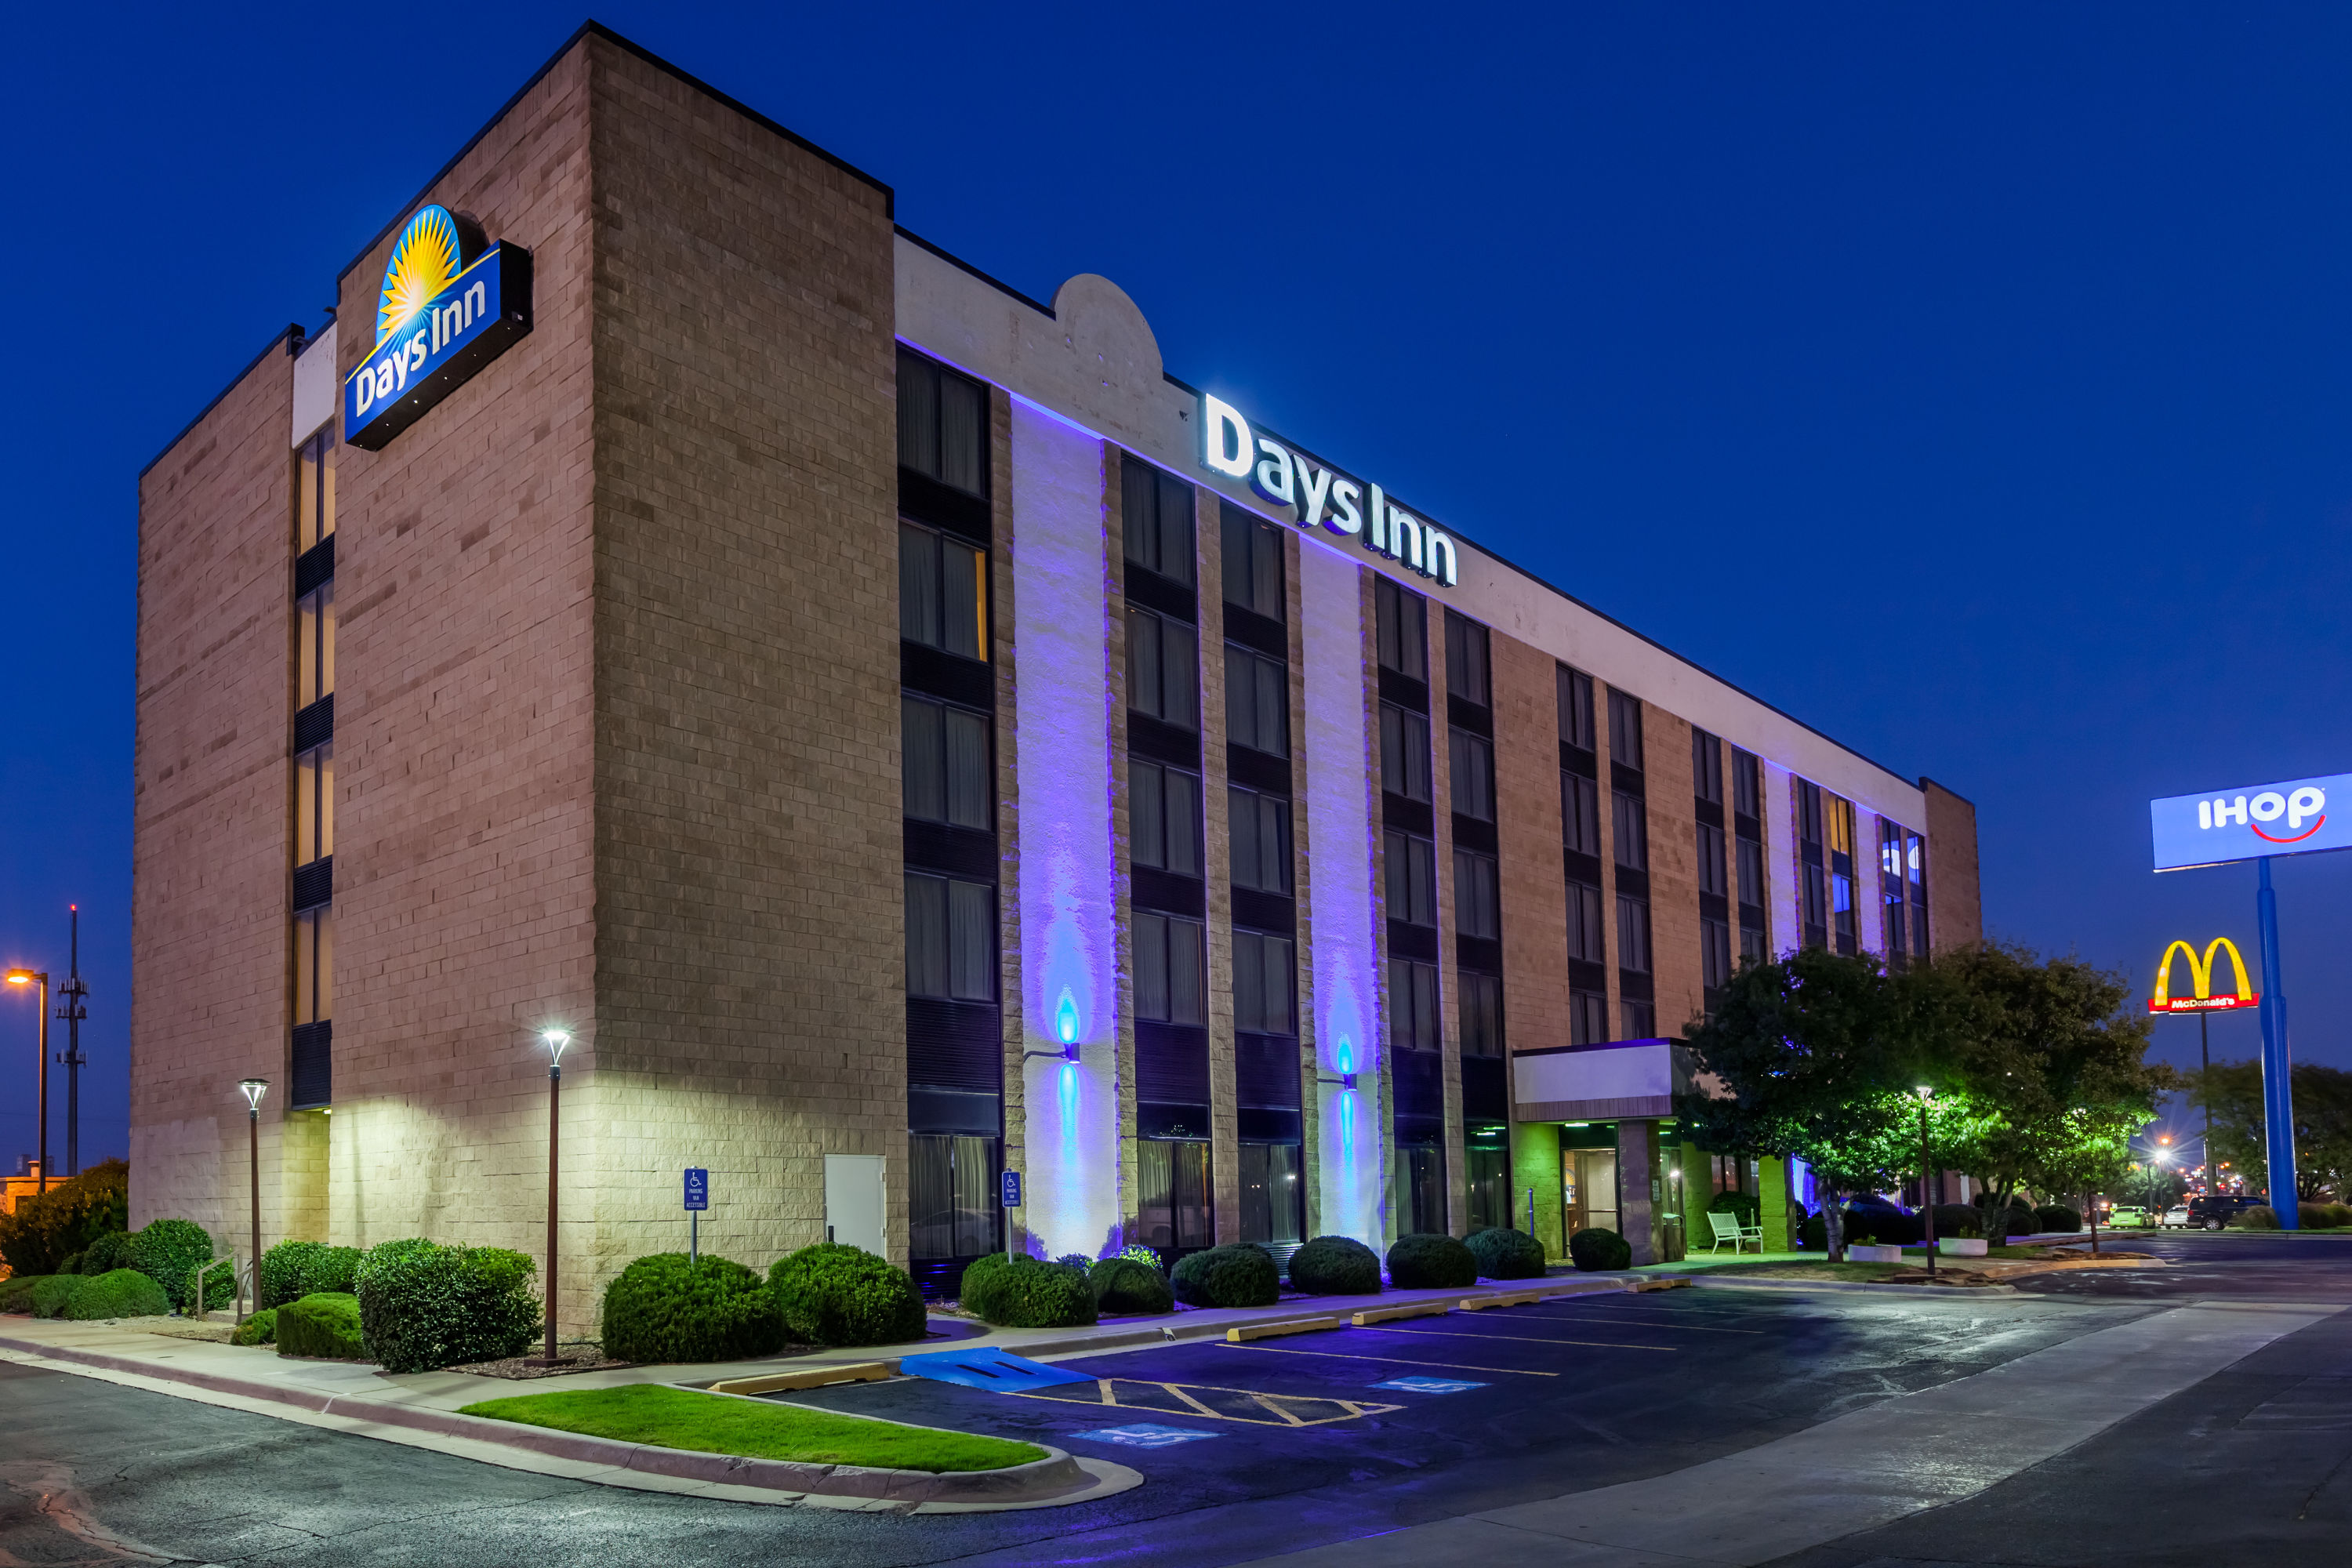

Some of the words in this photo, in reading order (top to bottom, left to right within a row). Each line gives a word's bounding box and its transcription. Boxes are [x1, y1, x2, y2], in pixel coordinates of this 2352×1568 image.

[357, 328, 427, 418] Days
[432, 280, 485, 356] Inn
[1205, 393, 1363, 534] Days
[1370, 482, 1457, 586] Inn
[2198, 786, 2325, 829] IHOP
[2171, 997, 2235, 1009] McDonald's
